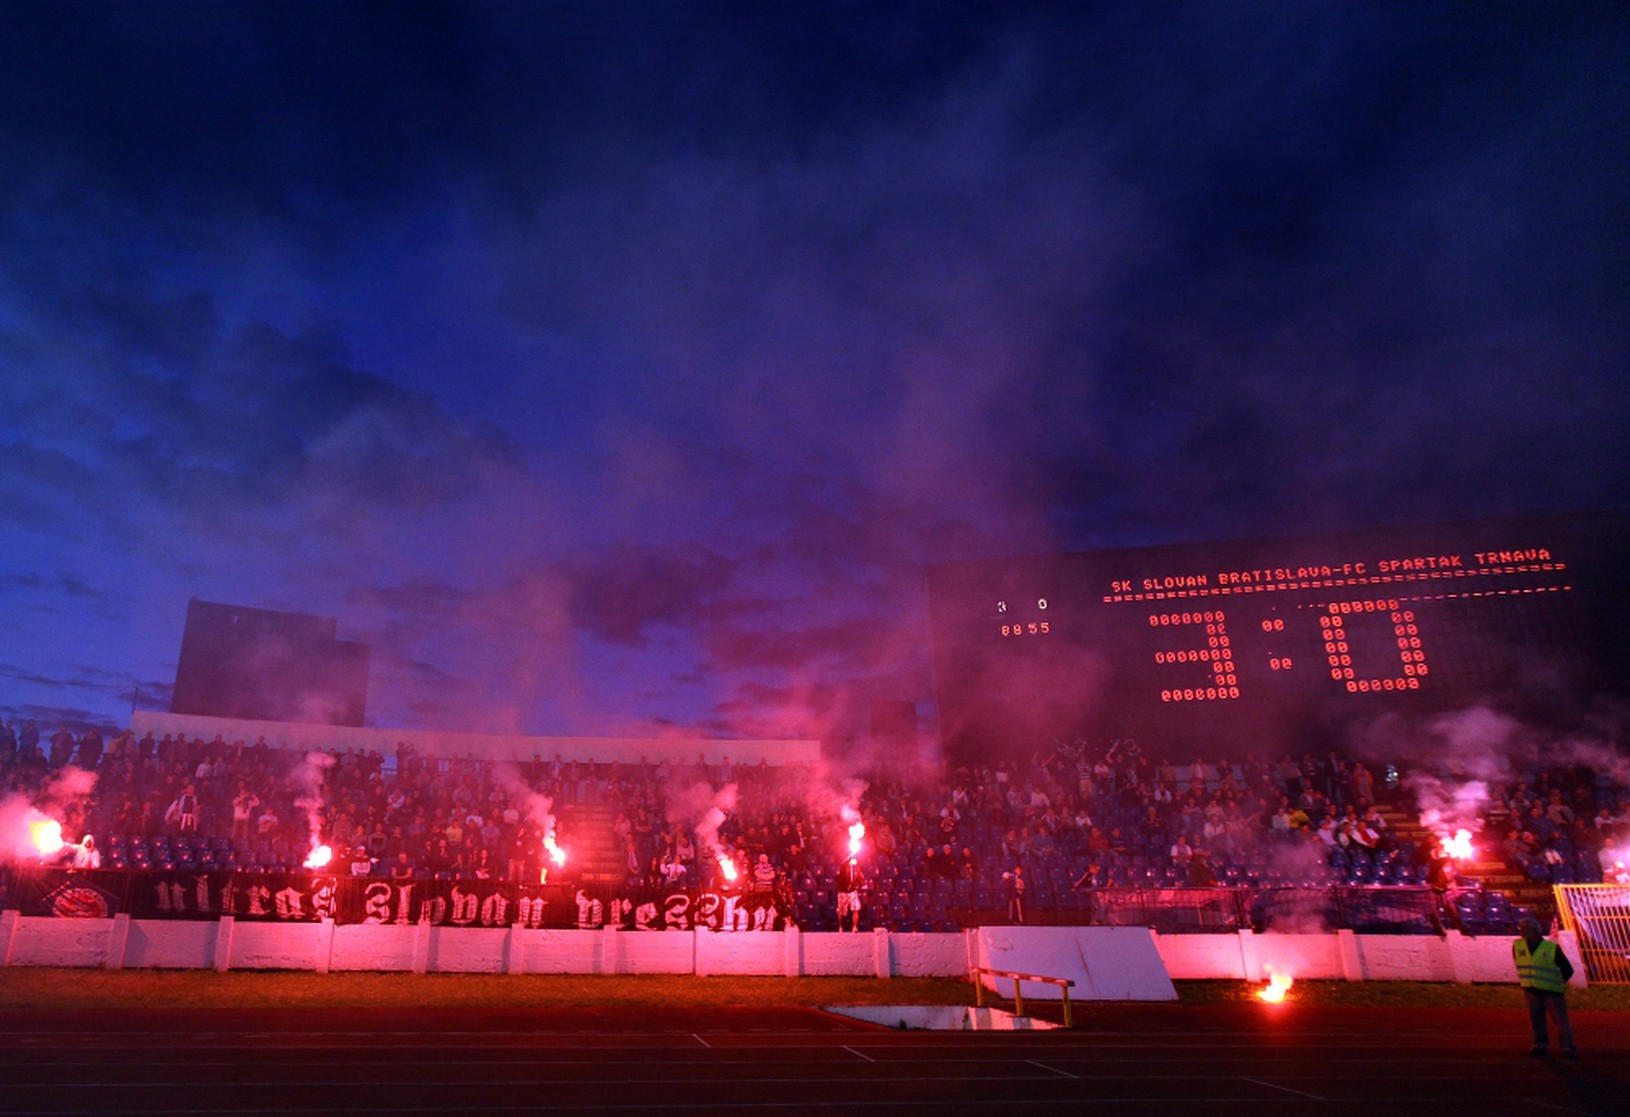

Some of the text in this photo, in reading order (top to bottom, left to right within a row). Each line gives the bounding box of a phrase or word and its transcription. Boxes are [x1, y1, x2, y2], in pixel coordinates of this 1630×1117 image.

[1111, 580, 1133, 594] SK
[1143, 574, 1208, 590] SLOVAN
[1378, 555, 1462, 574] SPARTAK
[1475, 548, 1551, 566] TRNAVA
